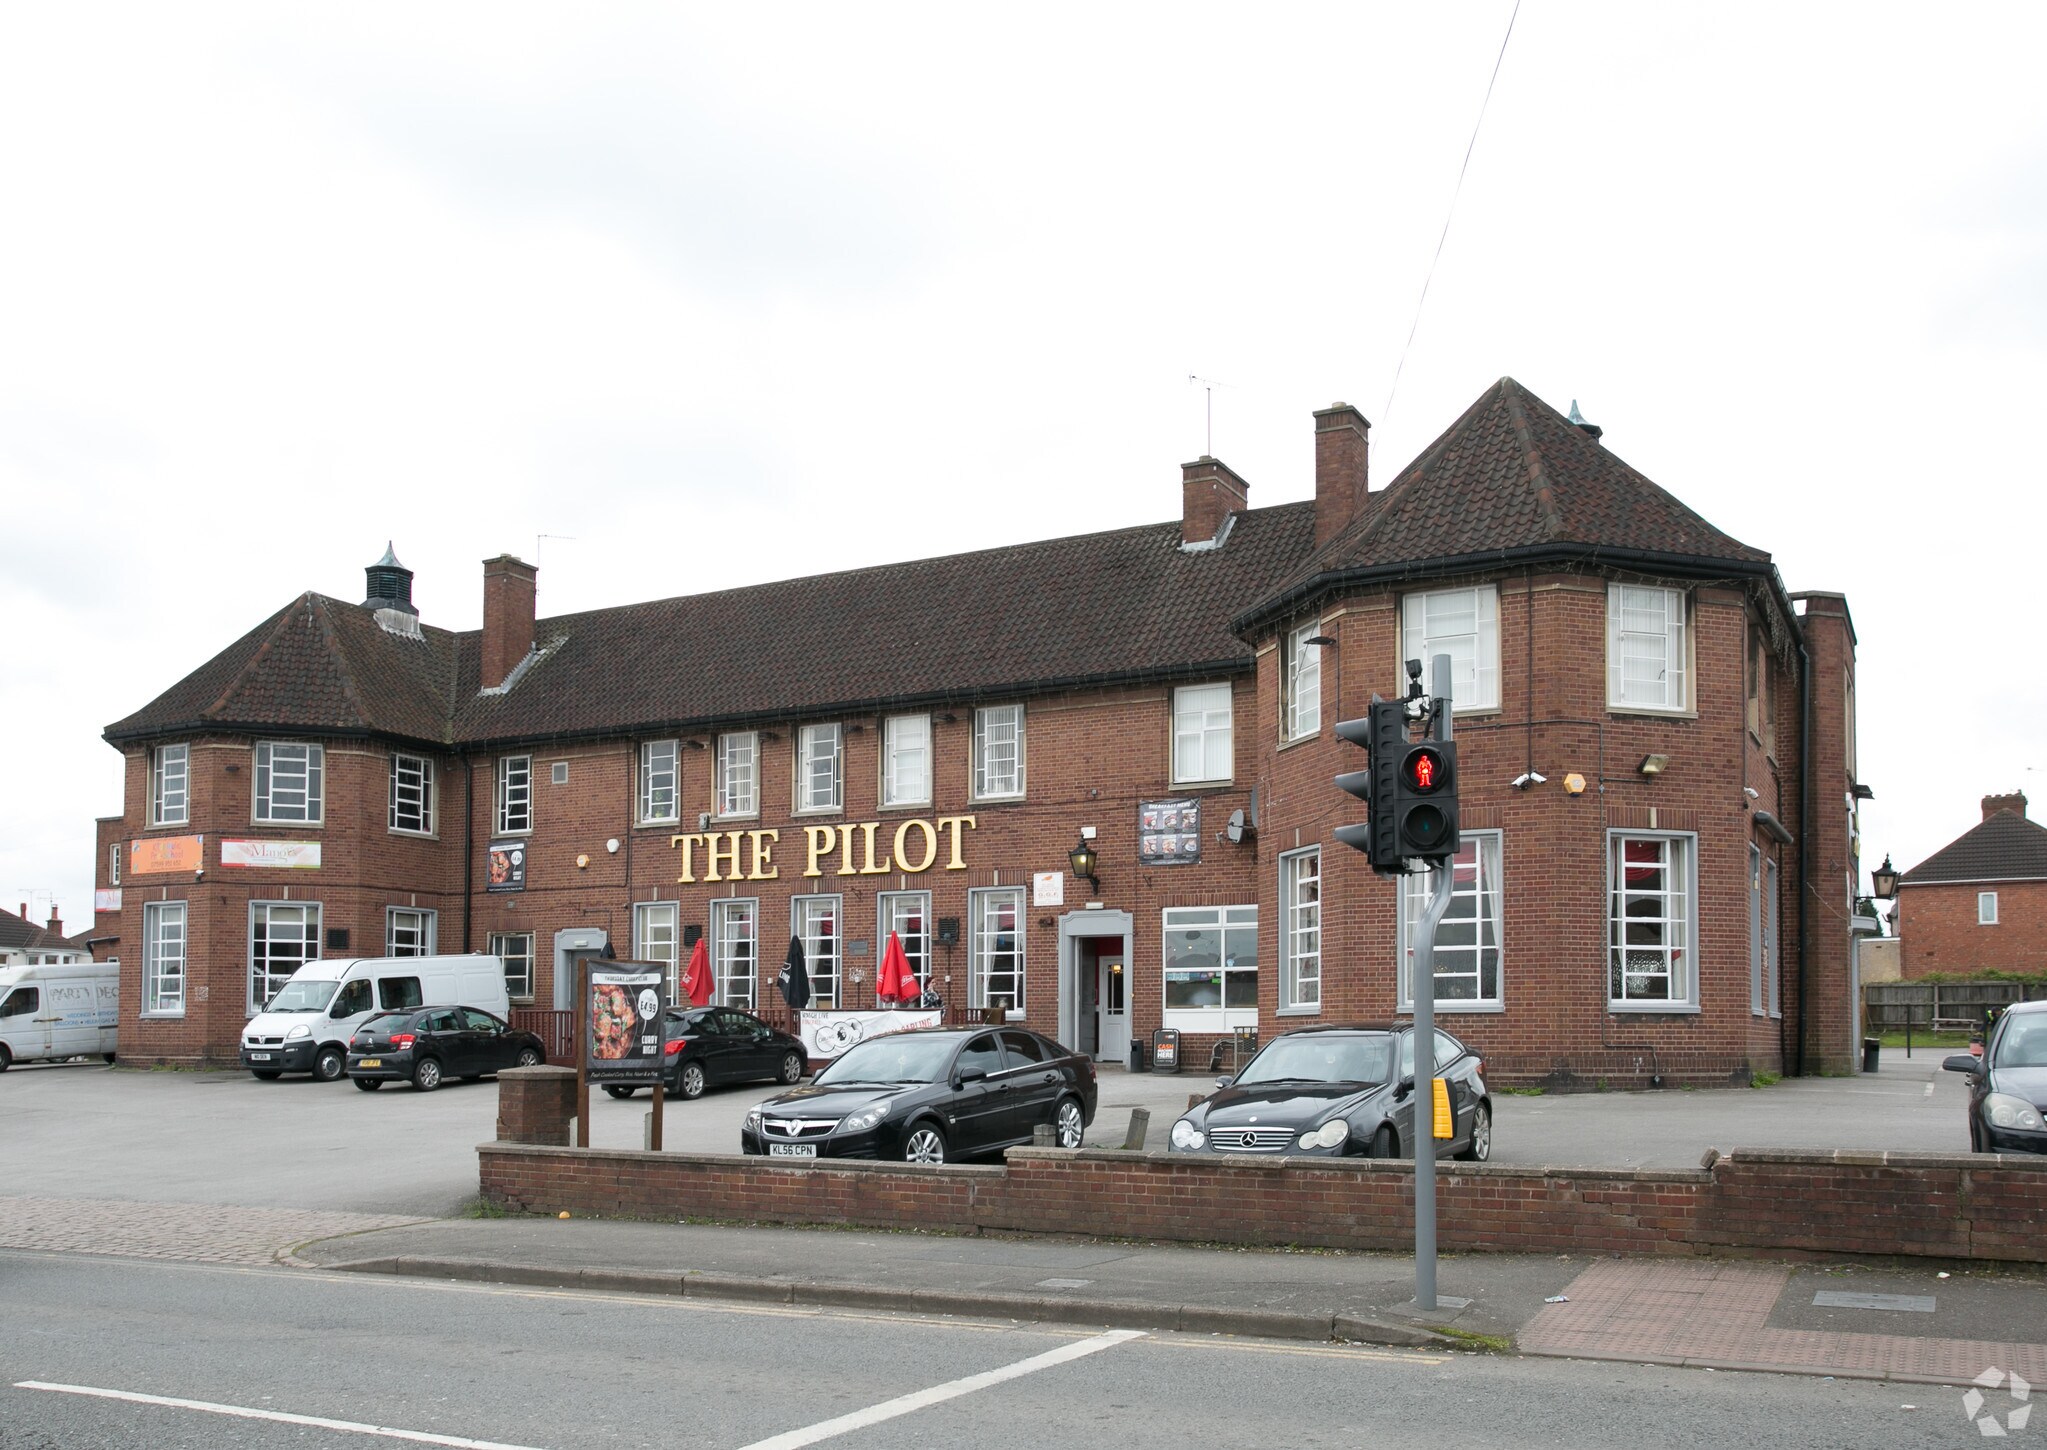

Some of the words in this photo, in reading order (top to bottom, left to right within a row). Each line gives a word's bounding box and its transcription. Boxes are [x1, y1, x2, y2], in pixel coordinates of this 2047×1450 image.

[671, 829, 779, 883] THE
[803, 815, 976, 877] PILOT
[640, 1001, 657, 1013] £4.99
[641, 1035, 658, 1044] CURRY
[642, 1046, 657, 1055] NIGHT
[772, 1145, 794, 1155] KL56
[794, 1145, 813, 1156] CPN
